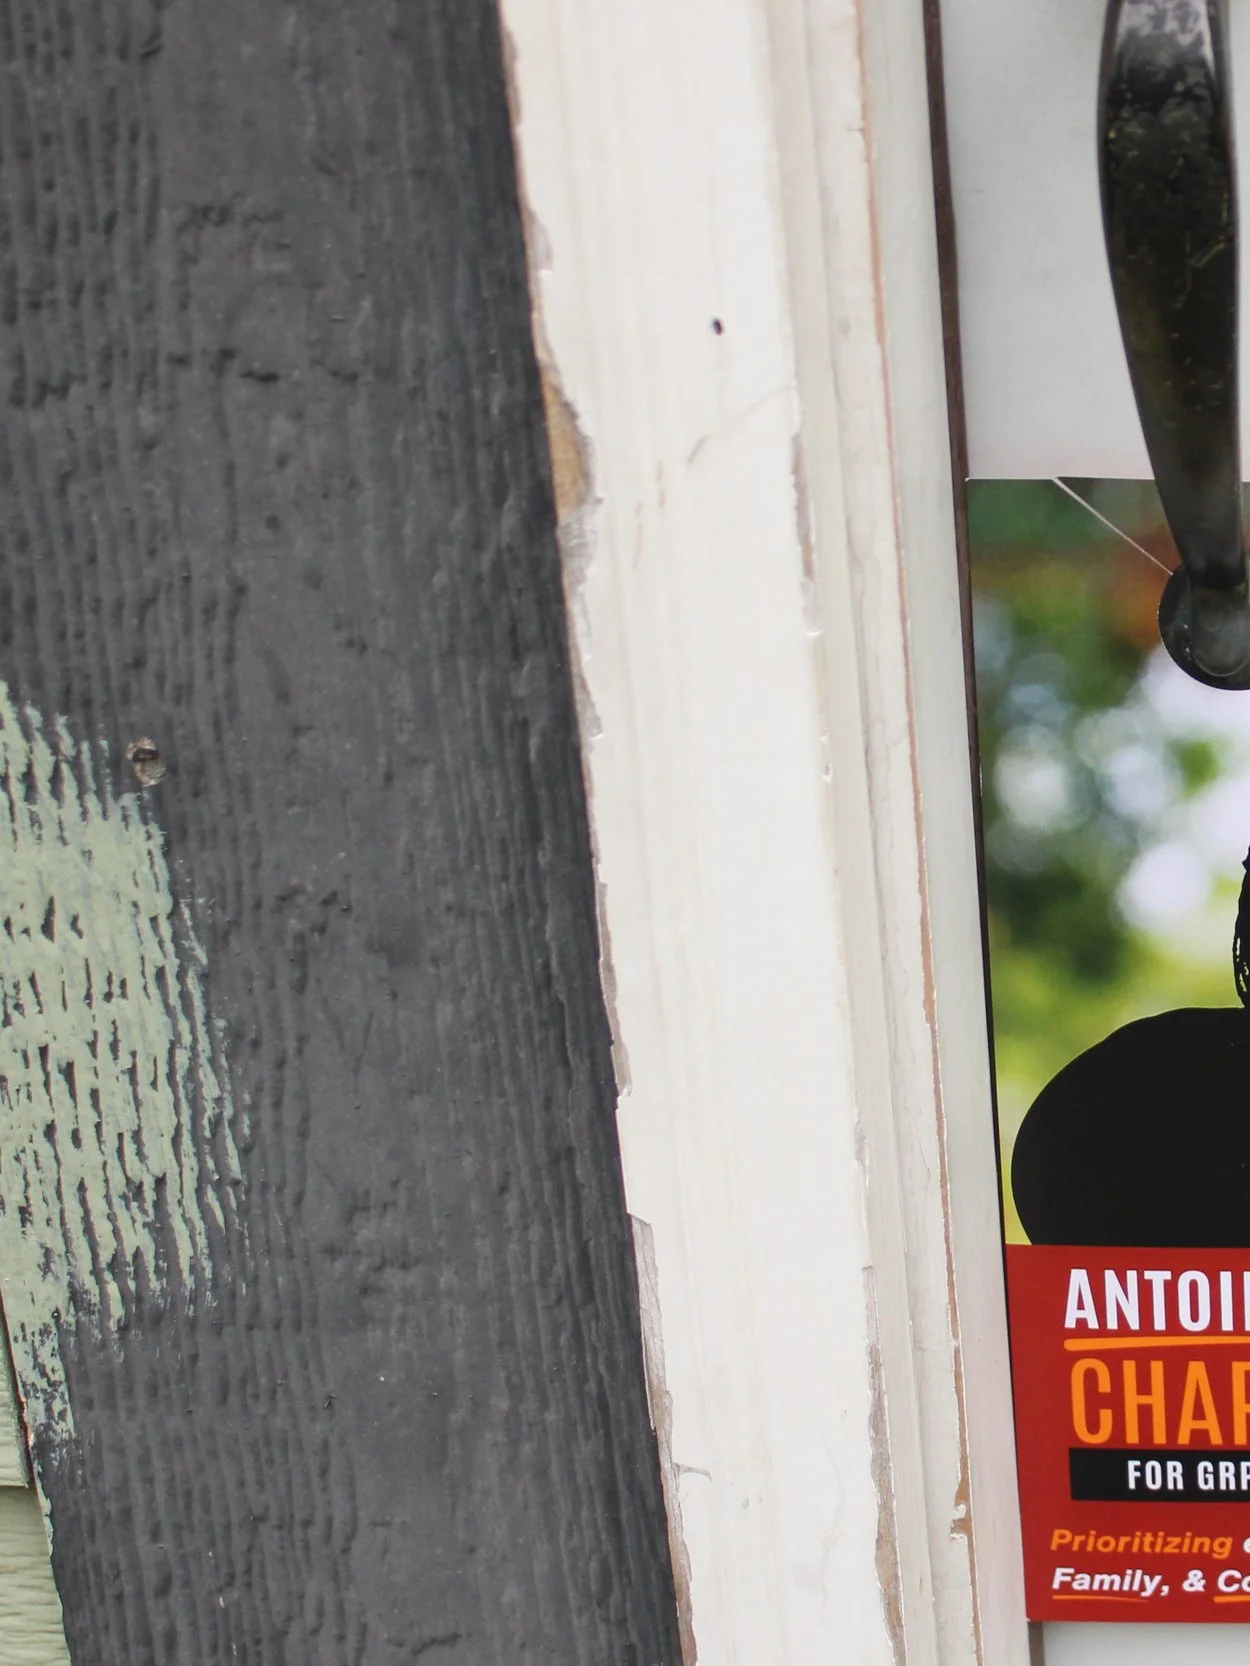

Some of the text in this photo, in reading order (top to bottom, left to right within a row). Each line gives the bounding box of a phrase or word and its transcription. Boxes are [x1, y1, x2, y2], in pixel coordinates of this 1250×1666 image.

[1126, 1459, 1184, 1489] FOR
[1050, 1528, 1232, 1558] Prioritizing
[1052, 1567, 1169, 1595] Family,
[1182, 1569, 1206, 1591] &
